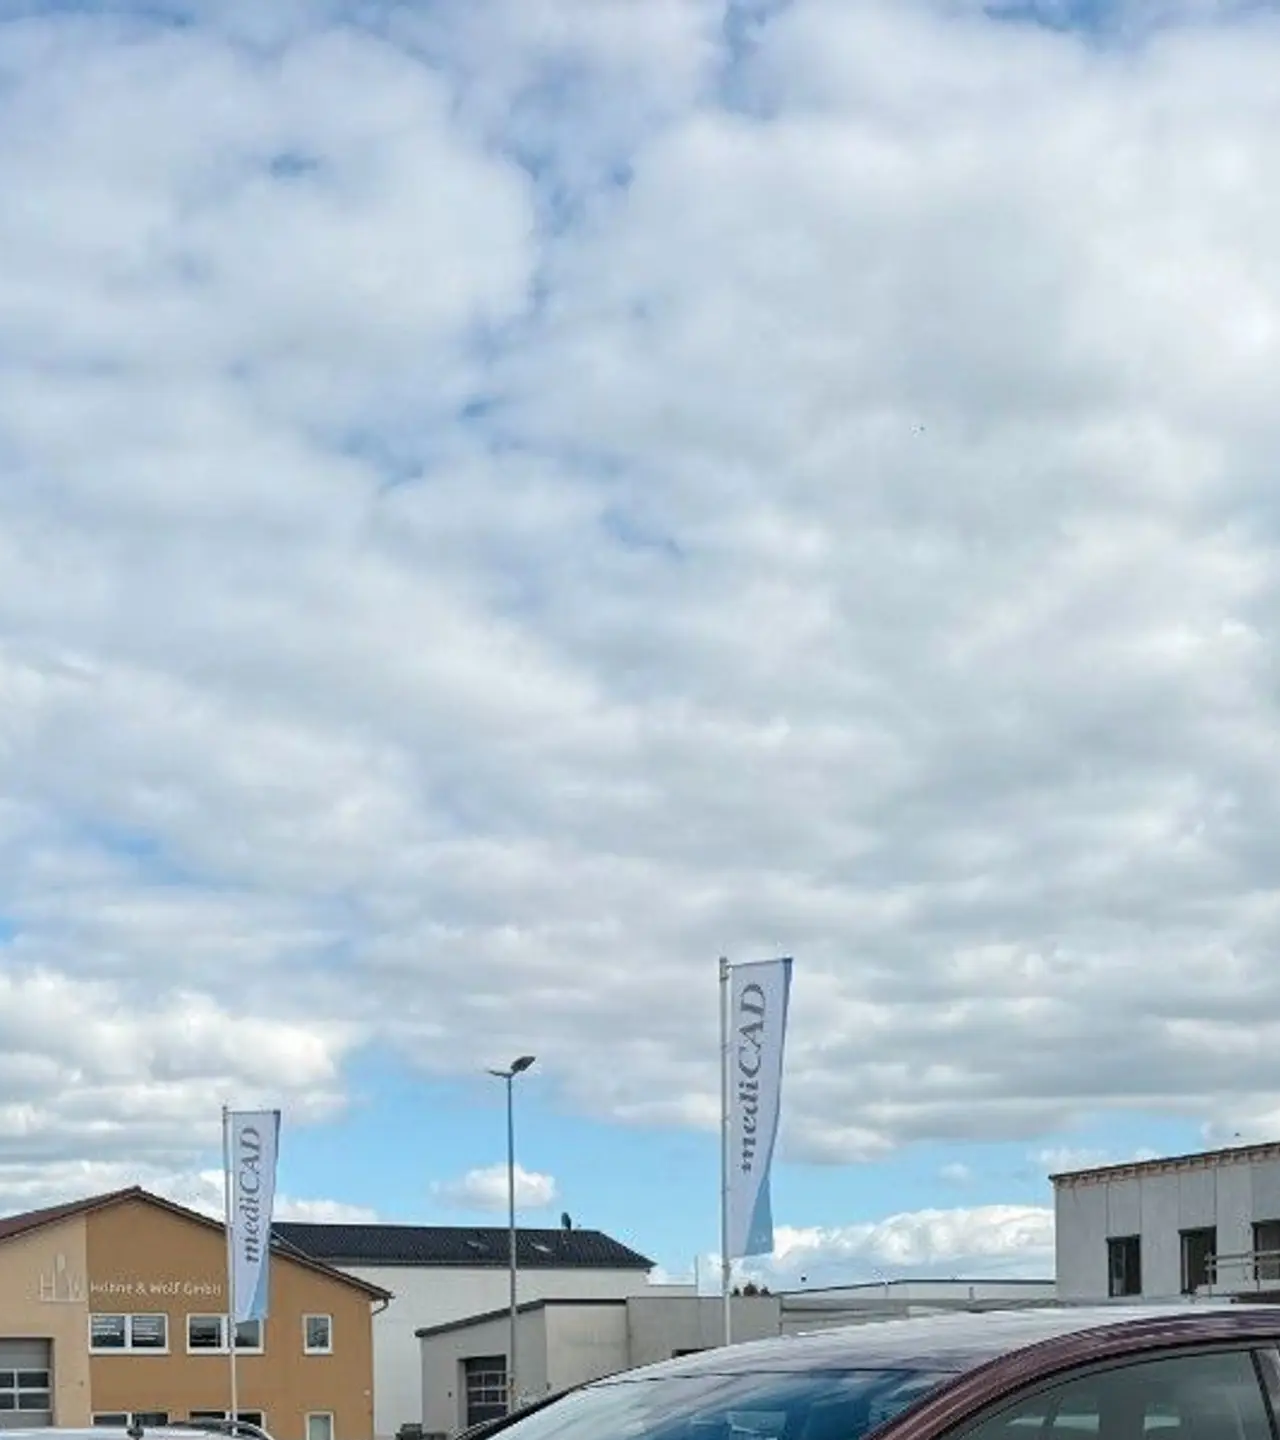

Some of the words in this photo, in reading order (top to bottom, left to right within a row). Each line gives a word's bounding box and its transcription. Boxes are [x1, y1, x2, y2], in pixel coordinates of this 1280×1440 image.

[737, 983, 766, 1172] mediCAD
[240, 1127, 261, 1264] mediCAD
[134, 1281, 150, 1296] &
